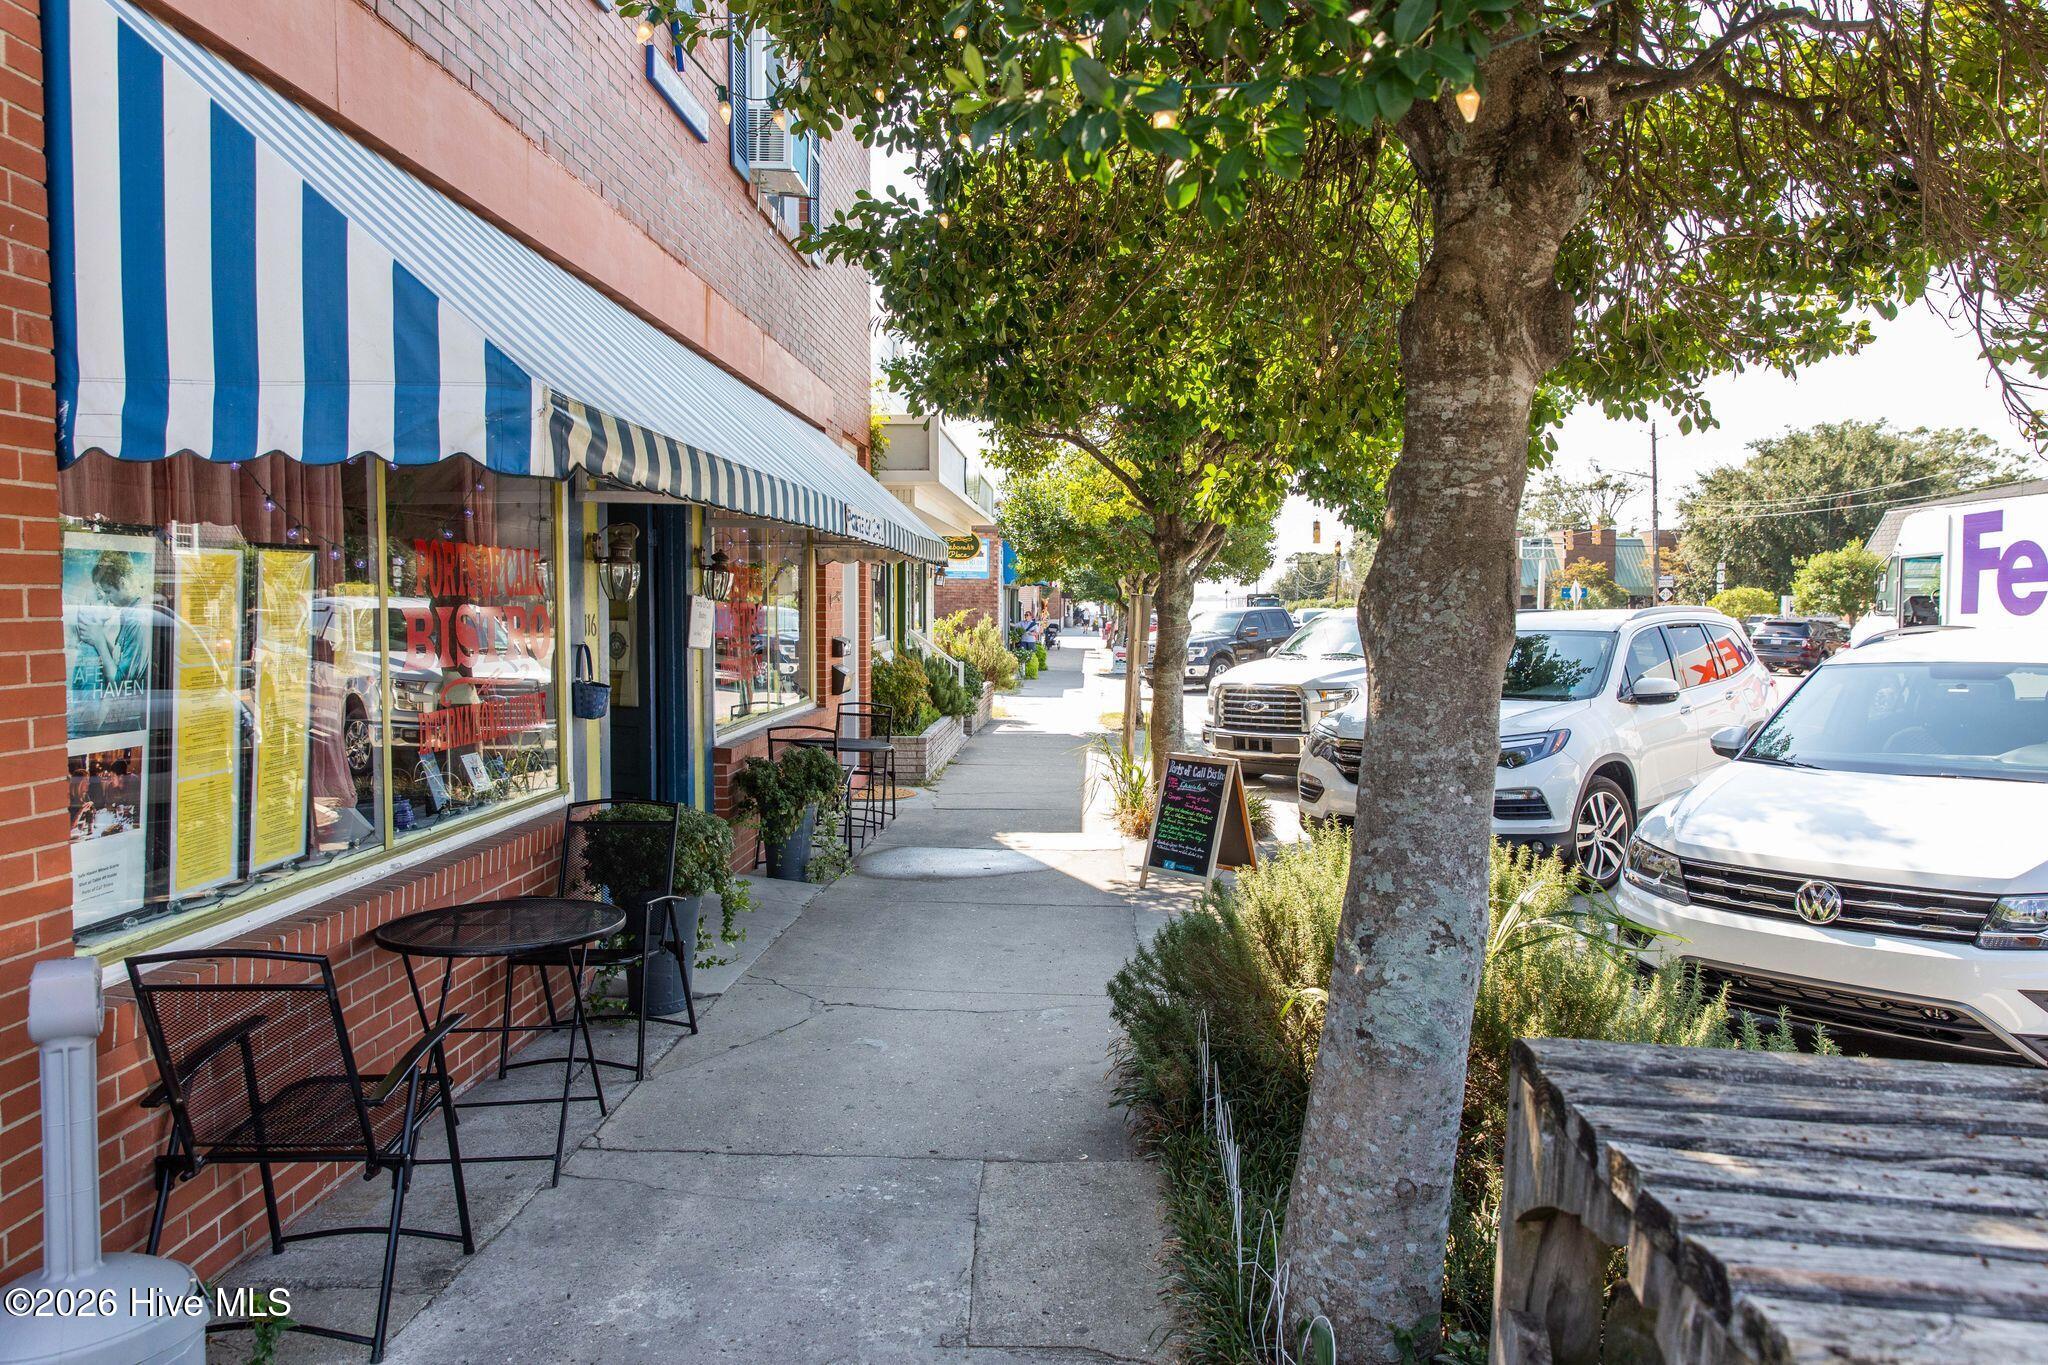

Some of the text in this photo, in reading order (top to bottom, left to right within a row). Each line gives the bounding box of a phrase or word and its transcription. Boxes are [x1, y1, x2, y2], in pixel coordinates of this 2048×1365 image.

[414, 538, 478, 599] PORTS
[584, 613, 597, 637] 116
[400, 603, 551, 671] BISTRO
[72, 665, 104, 684] AFE
[92, 679, 145, 700] HAVEN
[1184, 764, 1193, 777] of
[1192, 766, 1206, 778] Call
